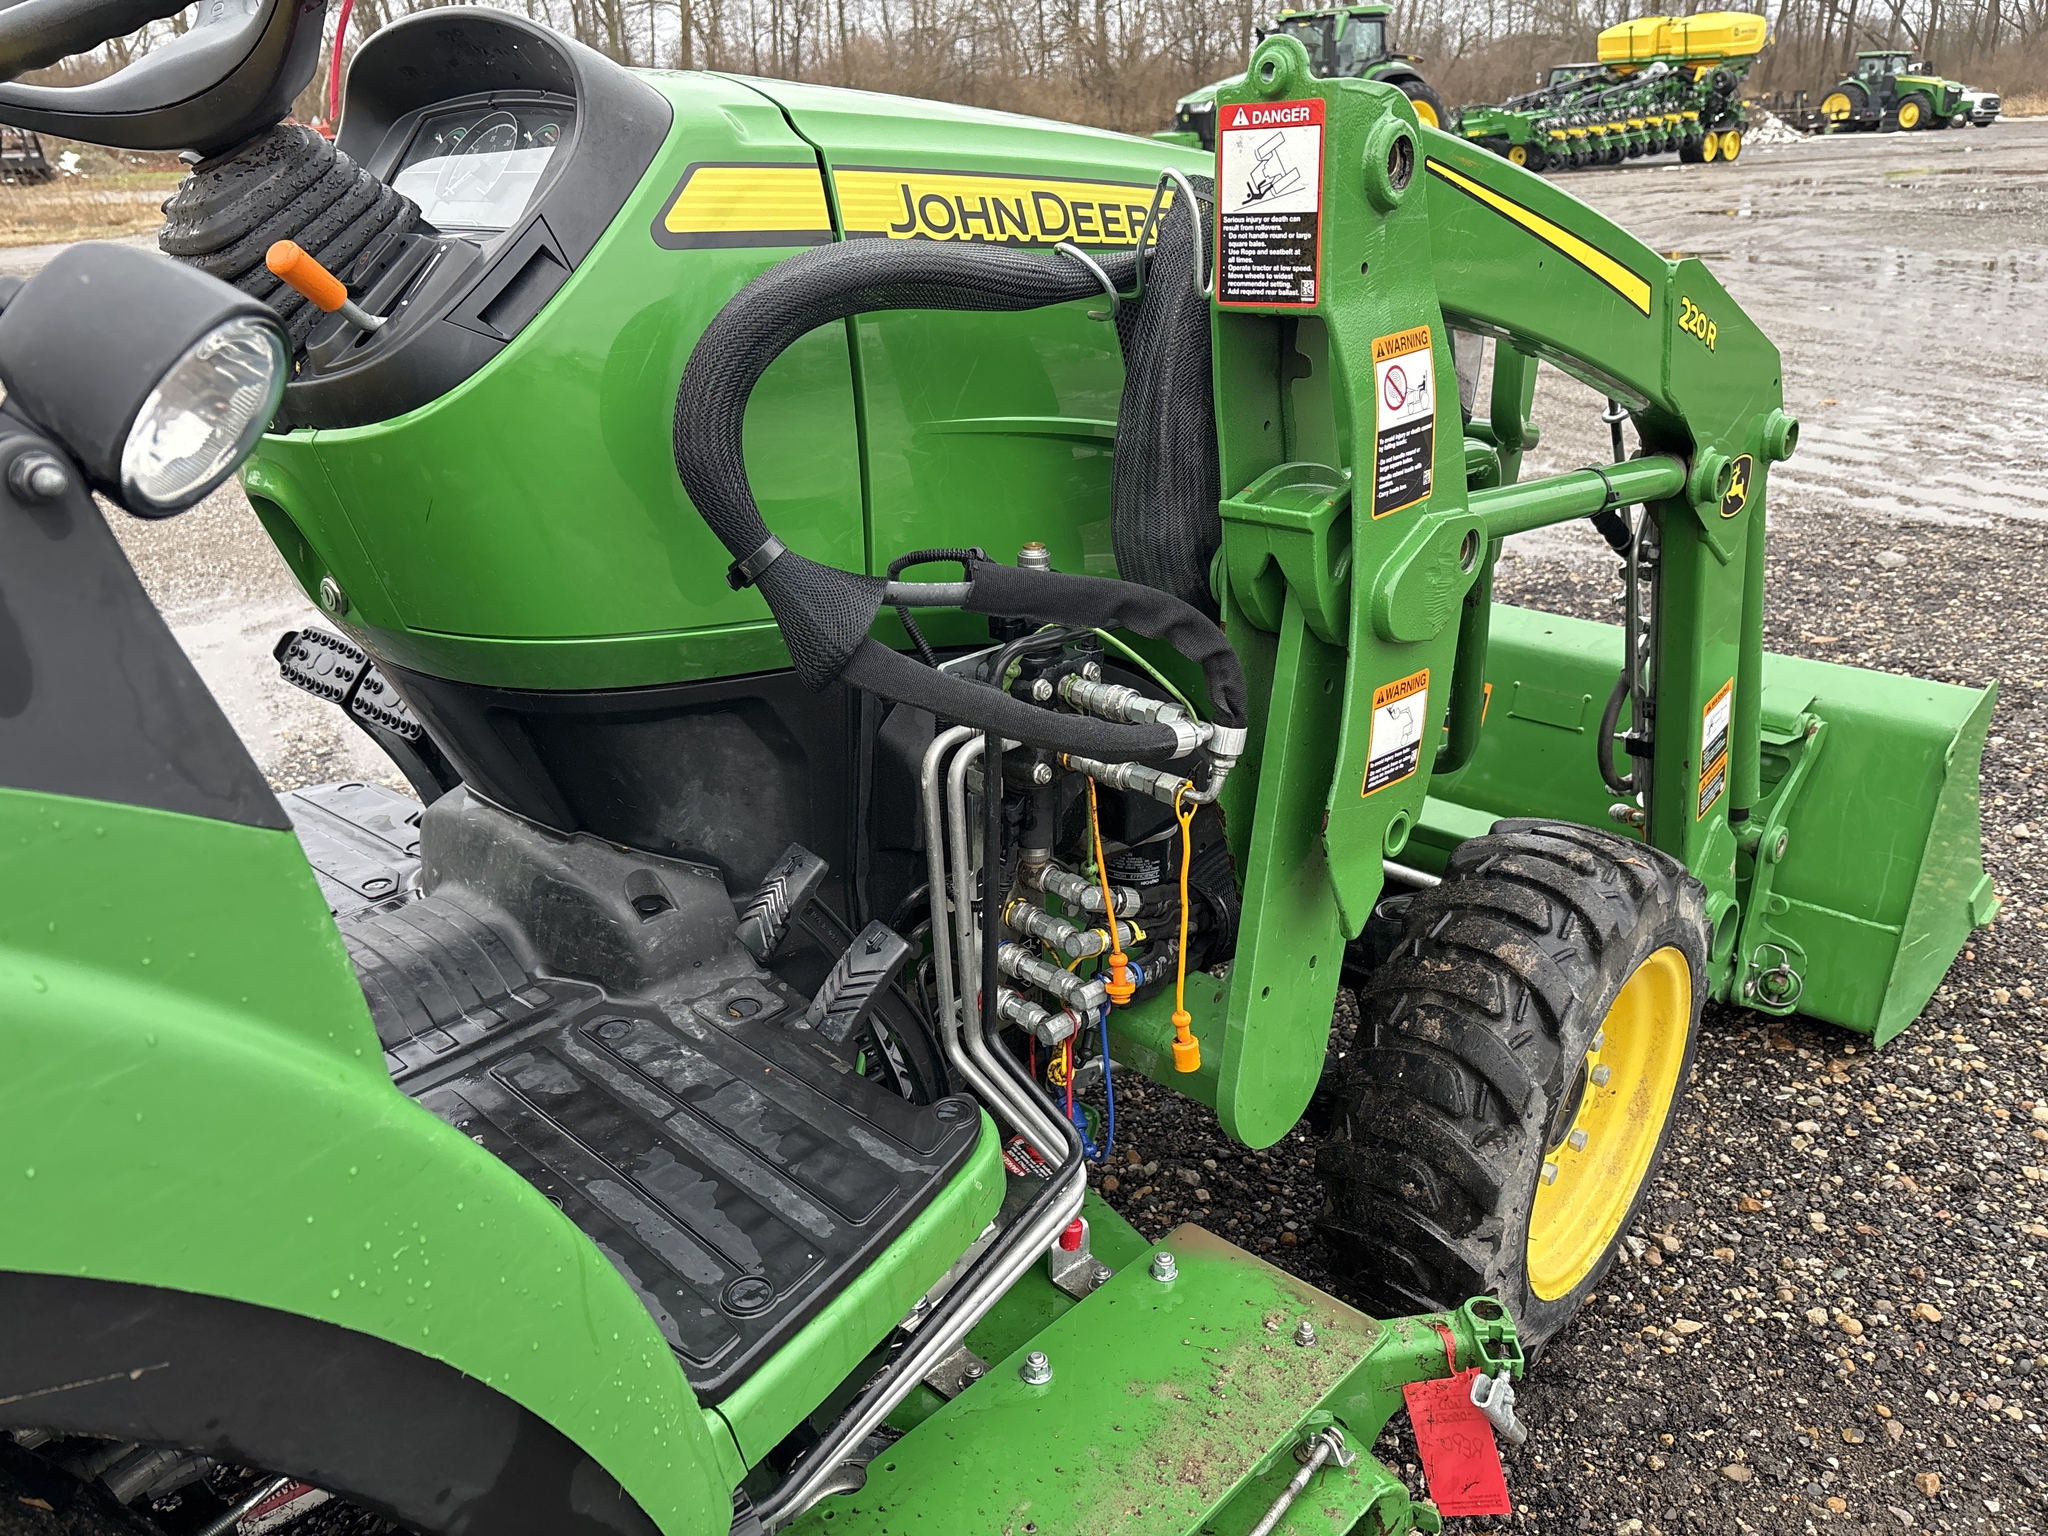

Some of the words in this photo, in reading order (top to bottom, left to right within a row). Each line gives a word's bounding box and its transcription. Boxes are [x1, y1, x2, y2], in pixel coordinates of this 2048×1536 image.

[1252, 107, 1310, 124] DANGER
[890, 184, 1030, 235] JOHN
[1246, 216, 1262, 224] injury
[1296, 232, 1311, 240] large
[1228, 264, 1251, 272] Operate
[1292, 264, 1313, 272] speed.
[1270, 280, 1292, 289] setting.
[1240, 288, 1264, 296] required
[1278, 288, 1299, 296] ballast.
[1384, 330, 1428, 355] WARNING
[1386, 673, 1426, 700] WARNING
